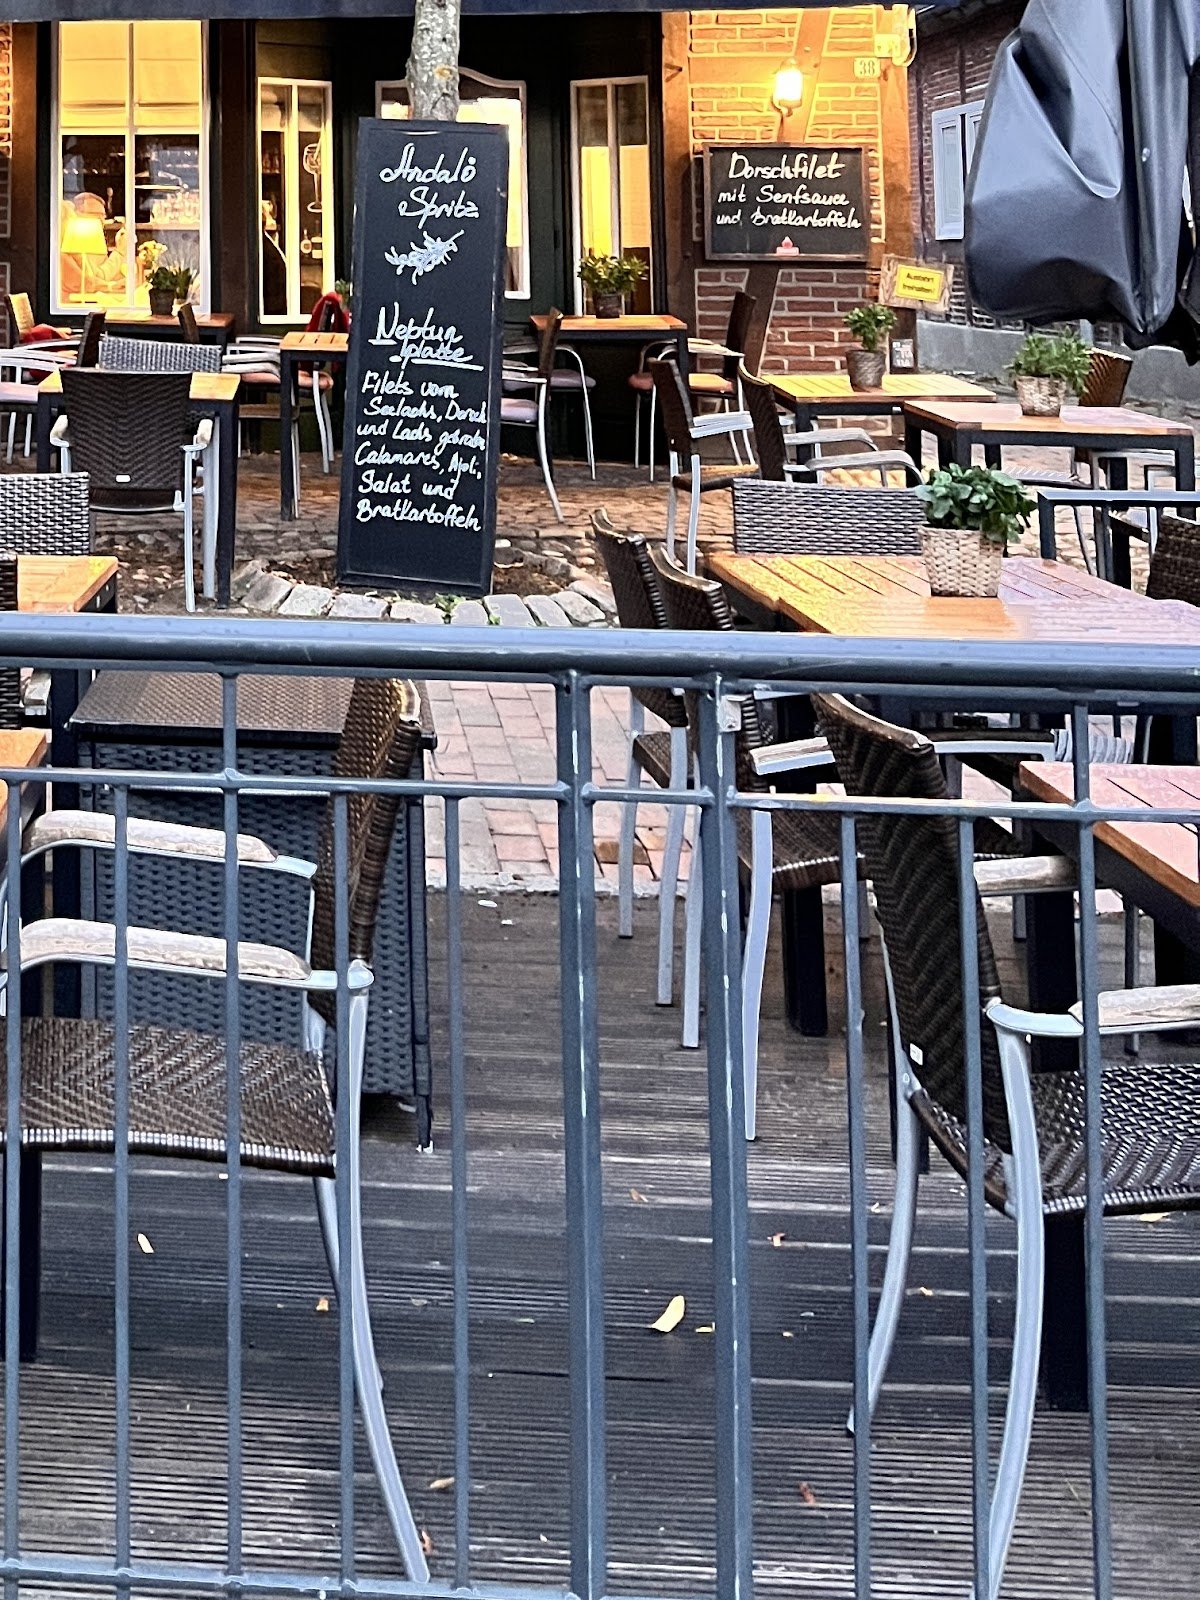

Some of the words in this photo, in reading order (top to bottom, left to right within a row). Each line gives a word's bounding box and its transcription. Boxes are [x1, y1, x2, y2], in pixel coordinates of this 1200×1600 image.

[728, 152, 846, 180] Dorschfilet
[398, 185, 479, 229] Spritz
[718, 183, 746, 203] mit
[755, 184, 849, 206] Senfsauce
[716, 208, 742, 225] und
[375, 301, 464, 350] Neptun
[361, 369, 414, 395] Filets
[420, 381, 460, 399] vom
[357, 418, 389, 436] und
[358, 469, 412, 493] Salat
[421, 478, 459, 500] und
